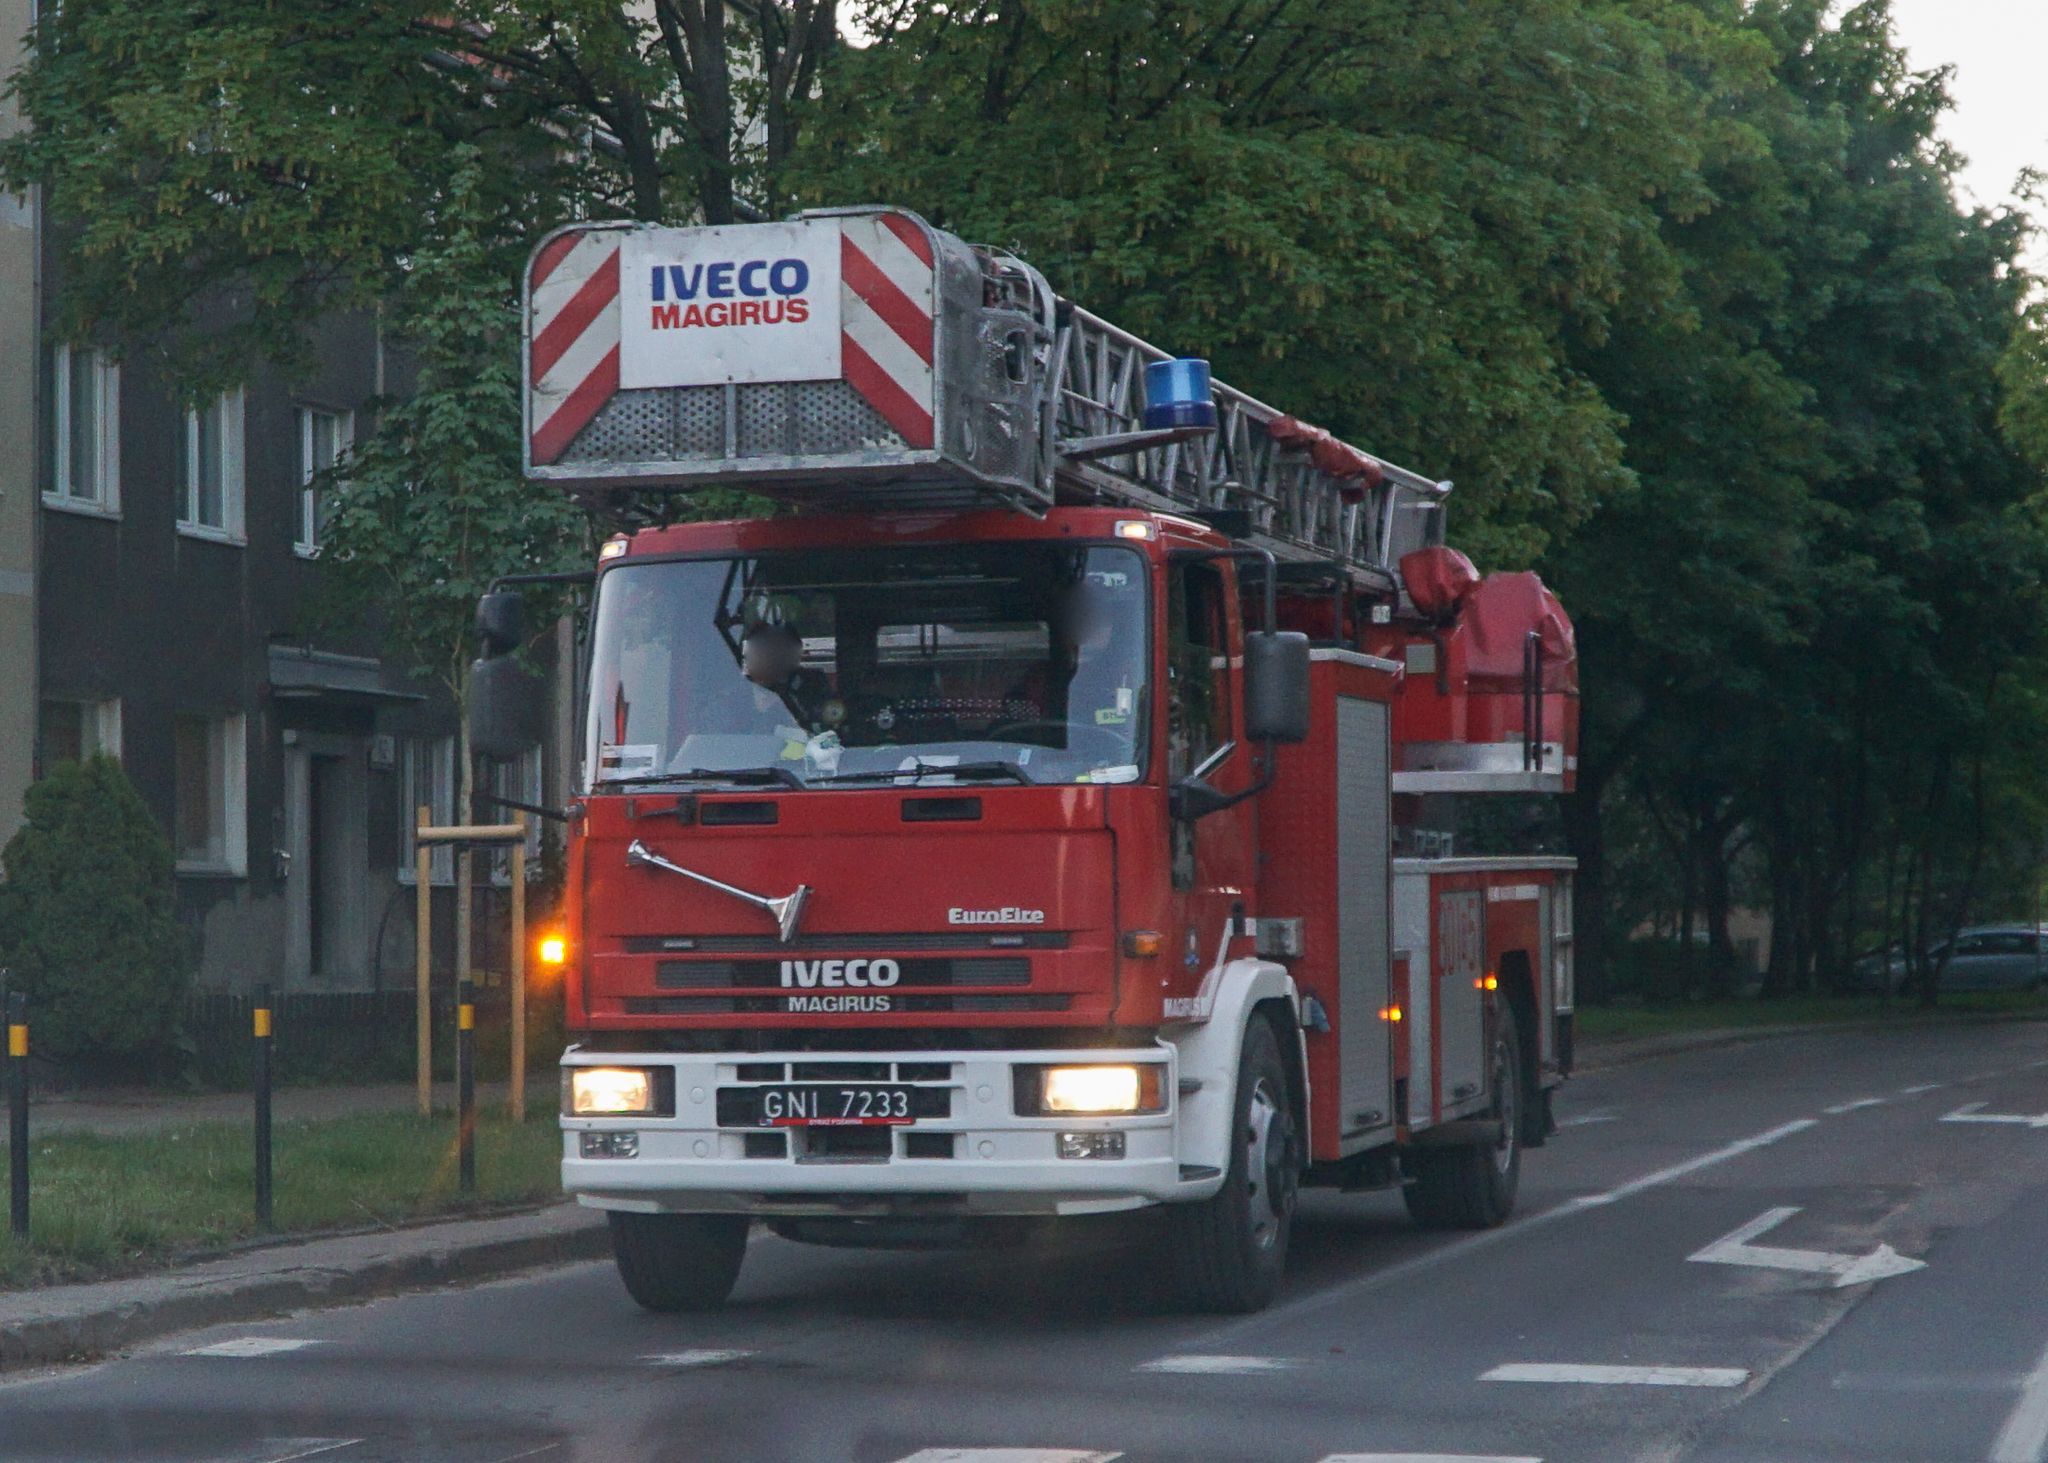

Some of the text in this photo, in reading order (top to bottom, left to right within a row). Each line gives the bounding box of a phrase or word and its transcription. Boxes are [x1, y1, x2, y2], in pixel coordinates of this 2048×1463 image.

[651, 259, 809, 301] IVECO
[651, 298, 809, 329] MAGIRUS
[781, 959, 899, 988] IVECO
[789, 996, 890, 1012] MAGIRUS
[764, 1091, 908, 1118] GNI 7233
